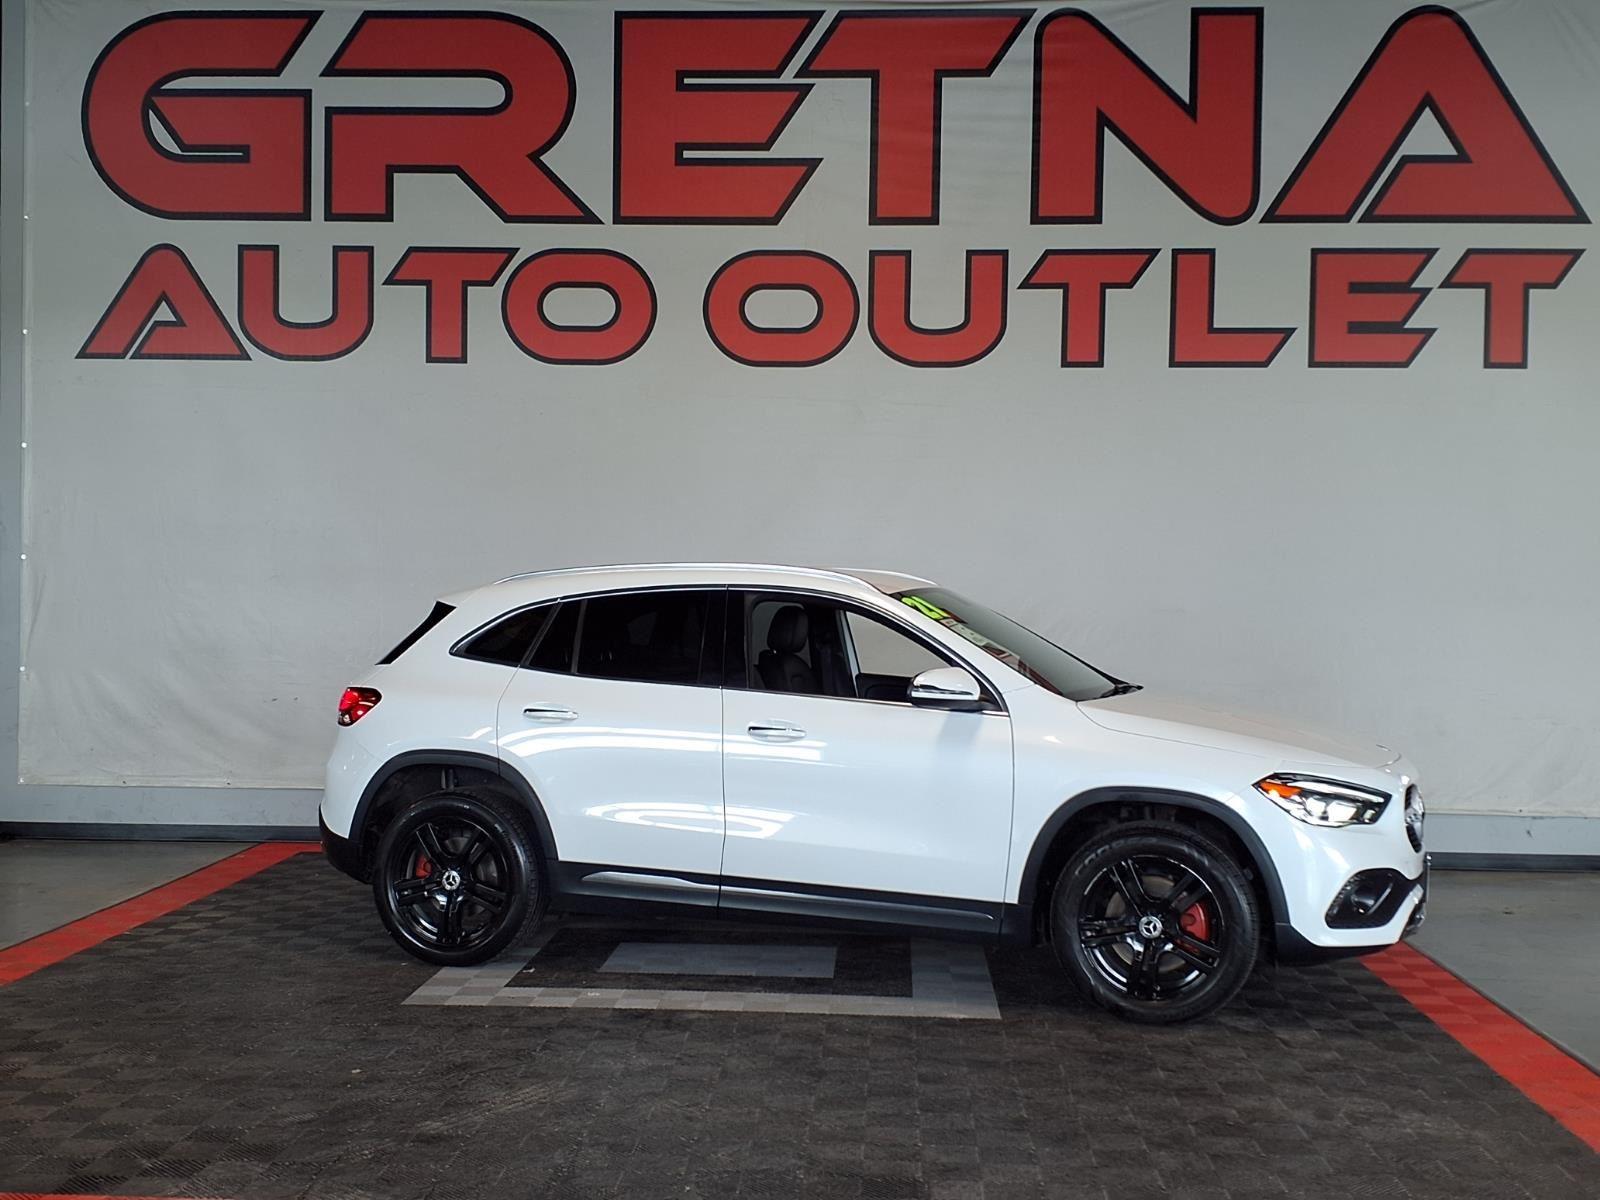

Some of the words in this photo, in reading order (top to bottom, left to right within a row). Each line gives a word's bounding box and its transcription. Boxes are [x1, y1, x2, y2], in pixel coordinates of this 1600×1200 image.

[81, 5, 1591, 226] GRETNA
[75, 243, 657, 365] AUTO
[703, 248, 1585, 369] OUTLET
